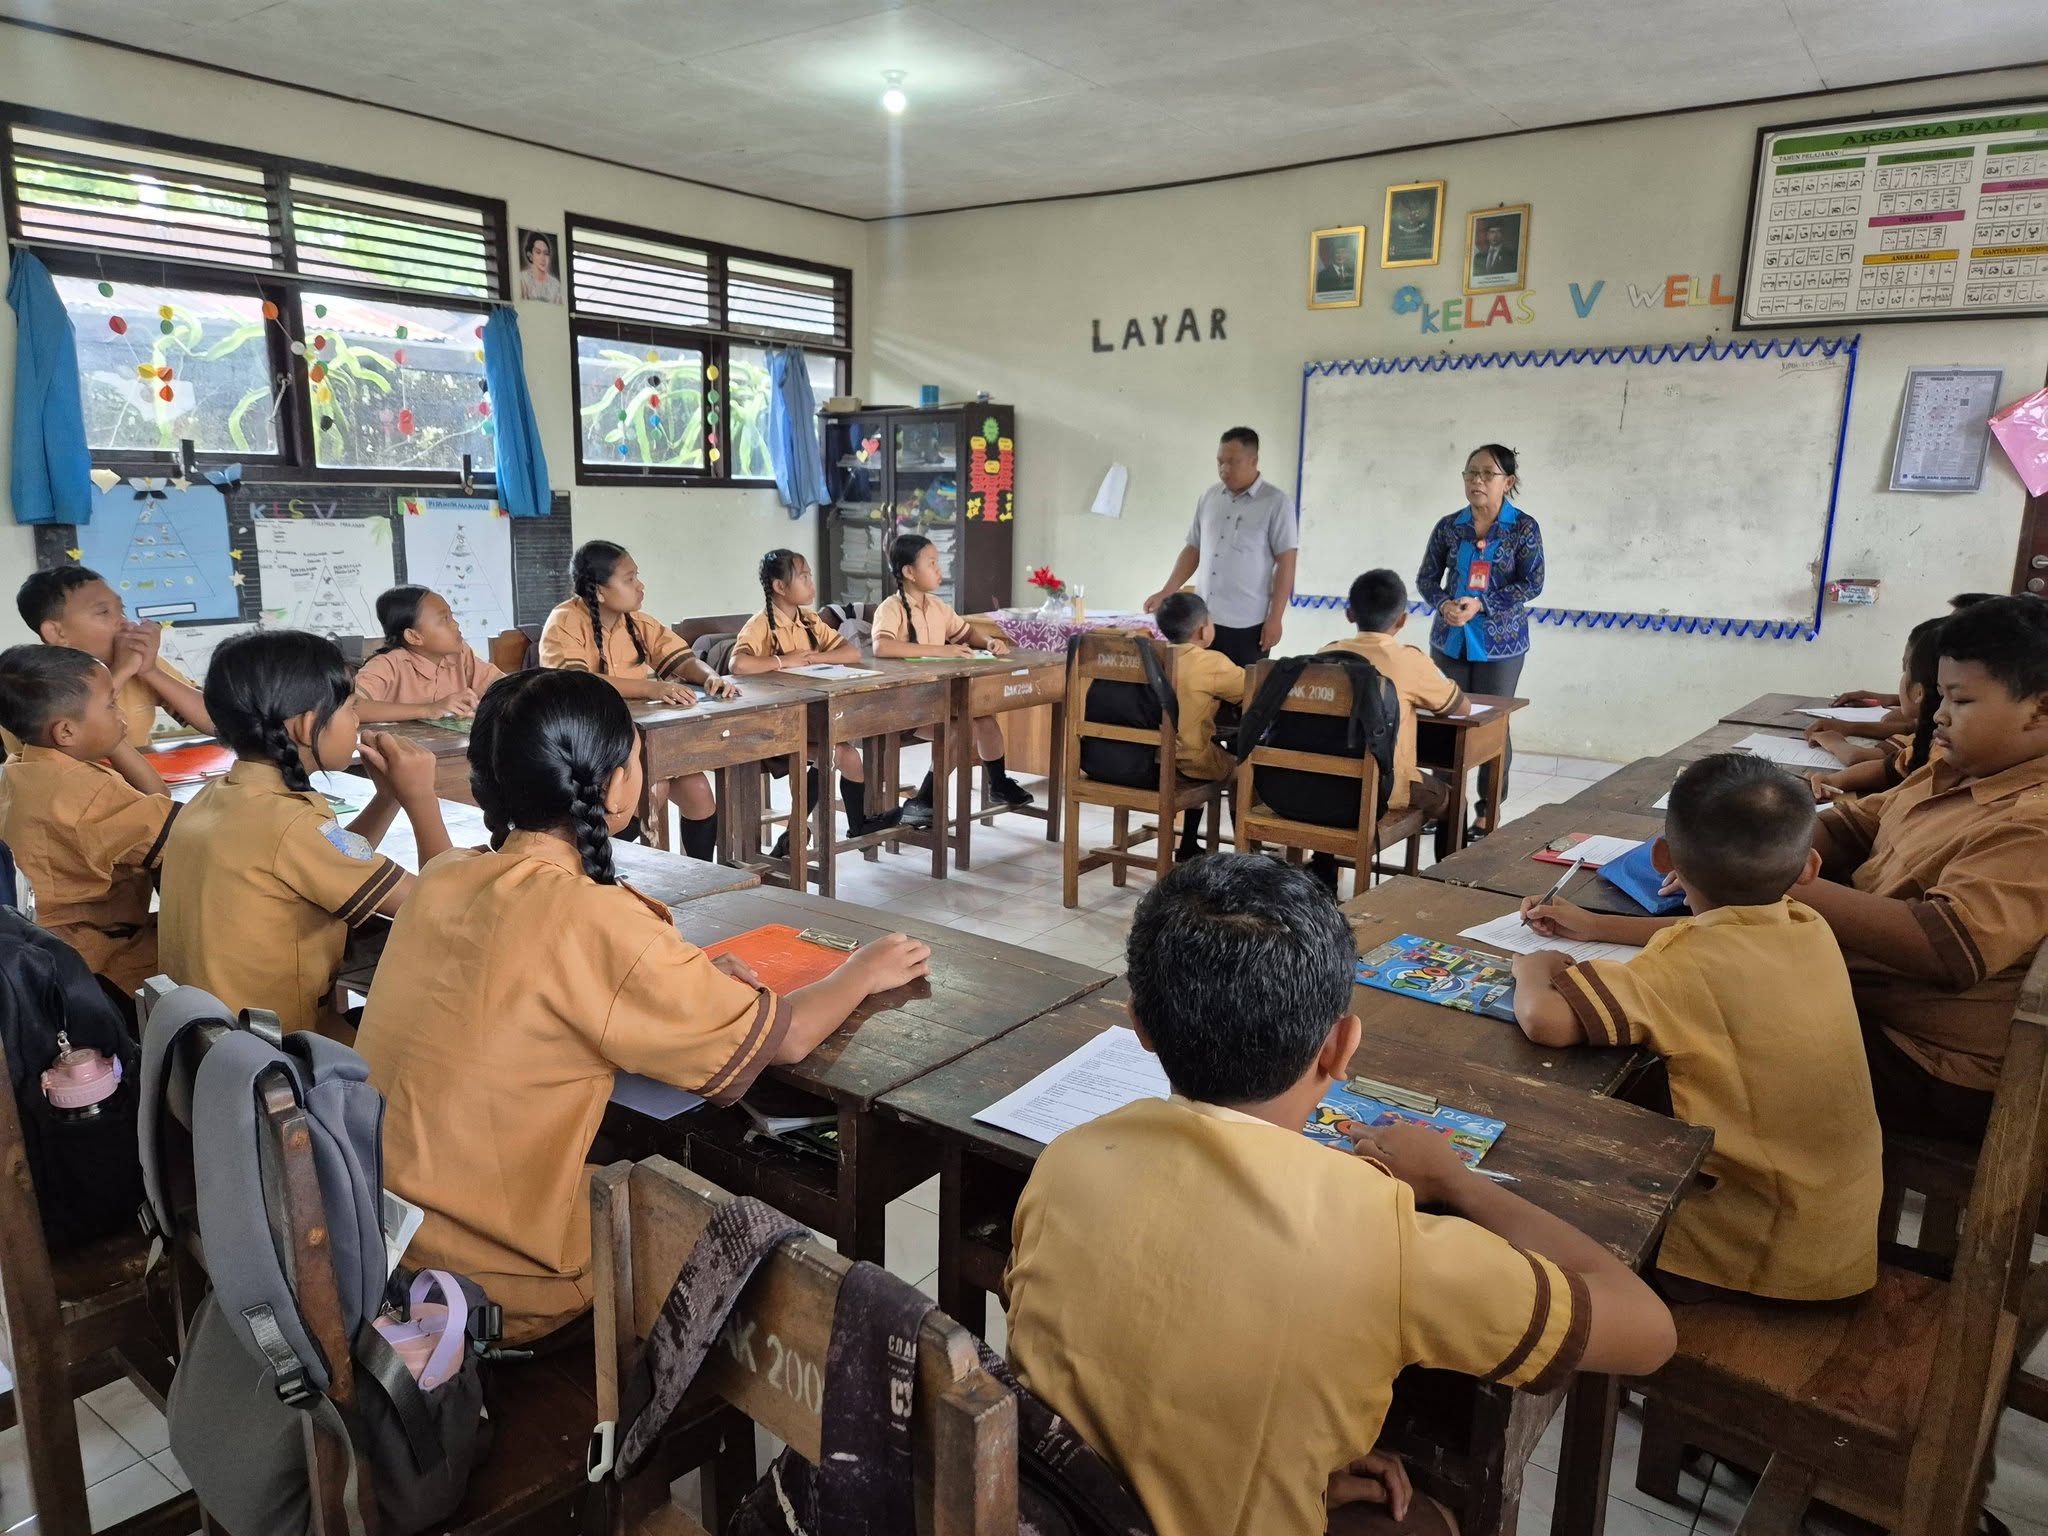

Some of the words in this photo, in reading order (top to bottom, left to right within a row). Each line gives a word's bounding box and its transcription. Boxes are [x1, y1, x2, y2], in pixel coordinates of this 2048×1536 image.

[1842, 125, 1949, 145] AKSARA
[1957, 117, 2023, 137] BALI
[1568, 280, 1606, 319] V
[1625, 274, 1734, 309] WELL
[1092, 308, 1228, 353] LAYAR
[312, 501, 338, 520] V
[1308, 684, 1335, 702] 2009
[1391, 966, 1450, 991] TAYO
[766, 1334, 826, 1415] 200
